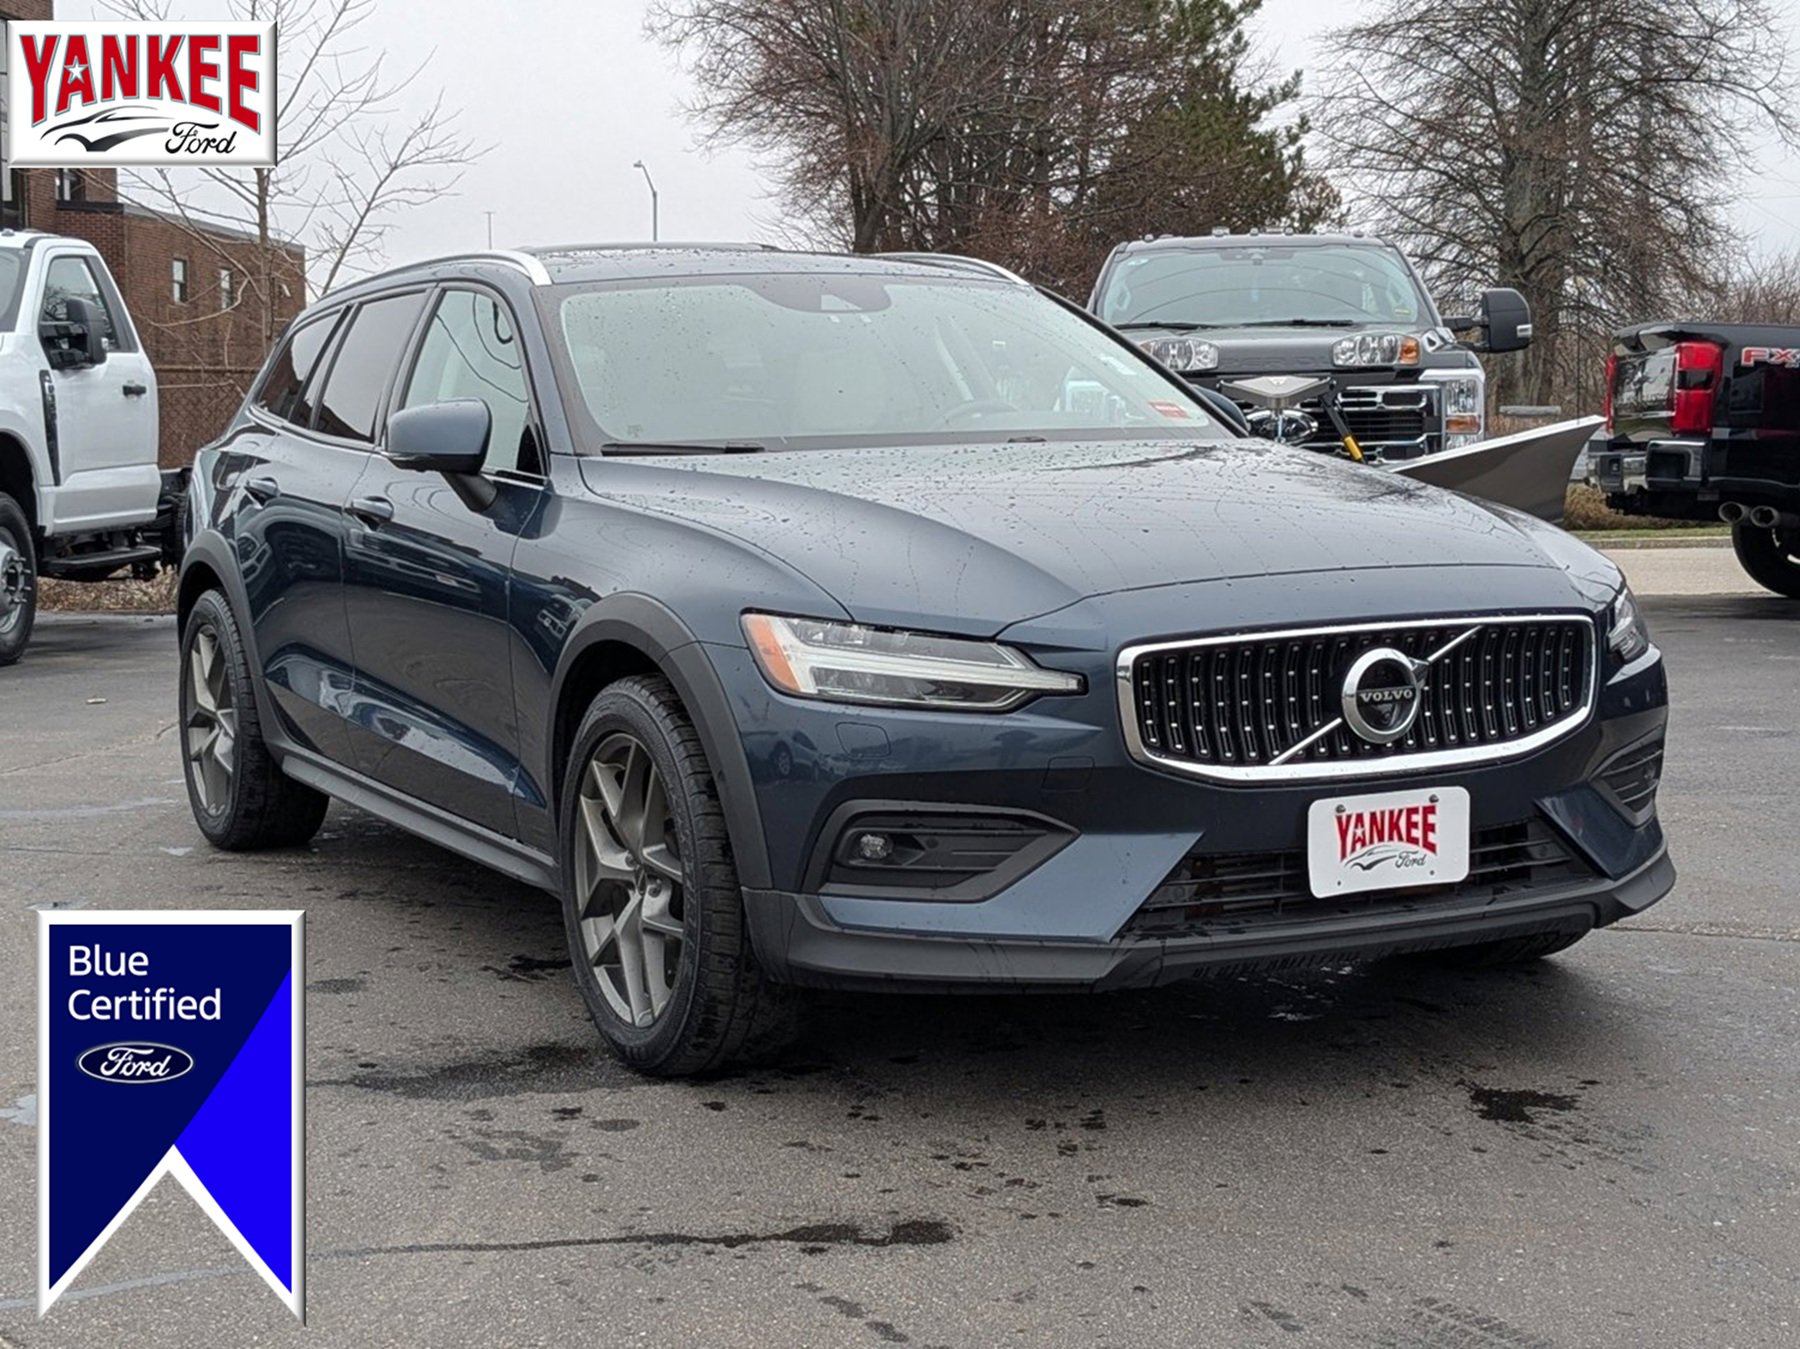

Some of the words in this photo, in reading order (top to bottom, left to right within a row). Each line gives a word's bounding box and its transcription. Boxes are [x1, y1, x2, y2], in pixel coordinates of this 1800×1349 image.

[1360, 689, 1413, 702] VOLVO
[1335, 804, 1437, 863] YANKEE
[1395, 850, 1427, 868] Ford
